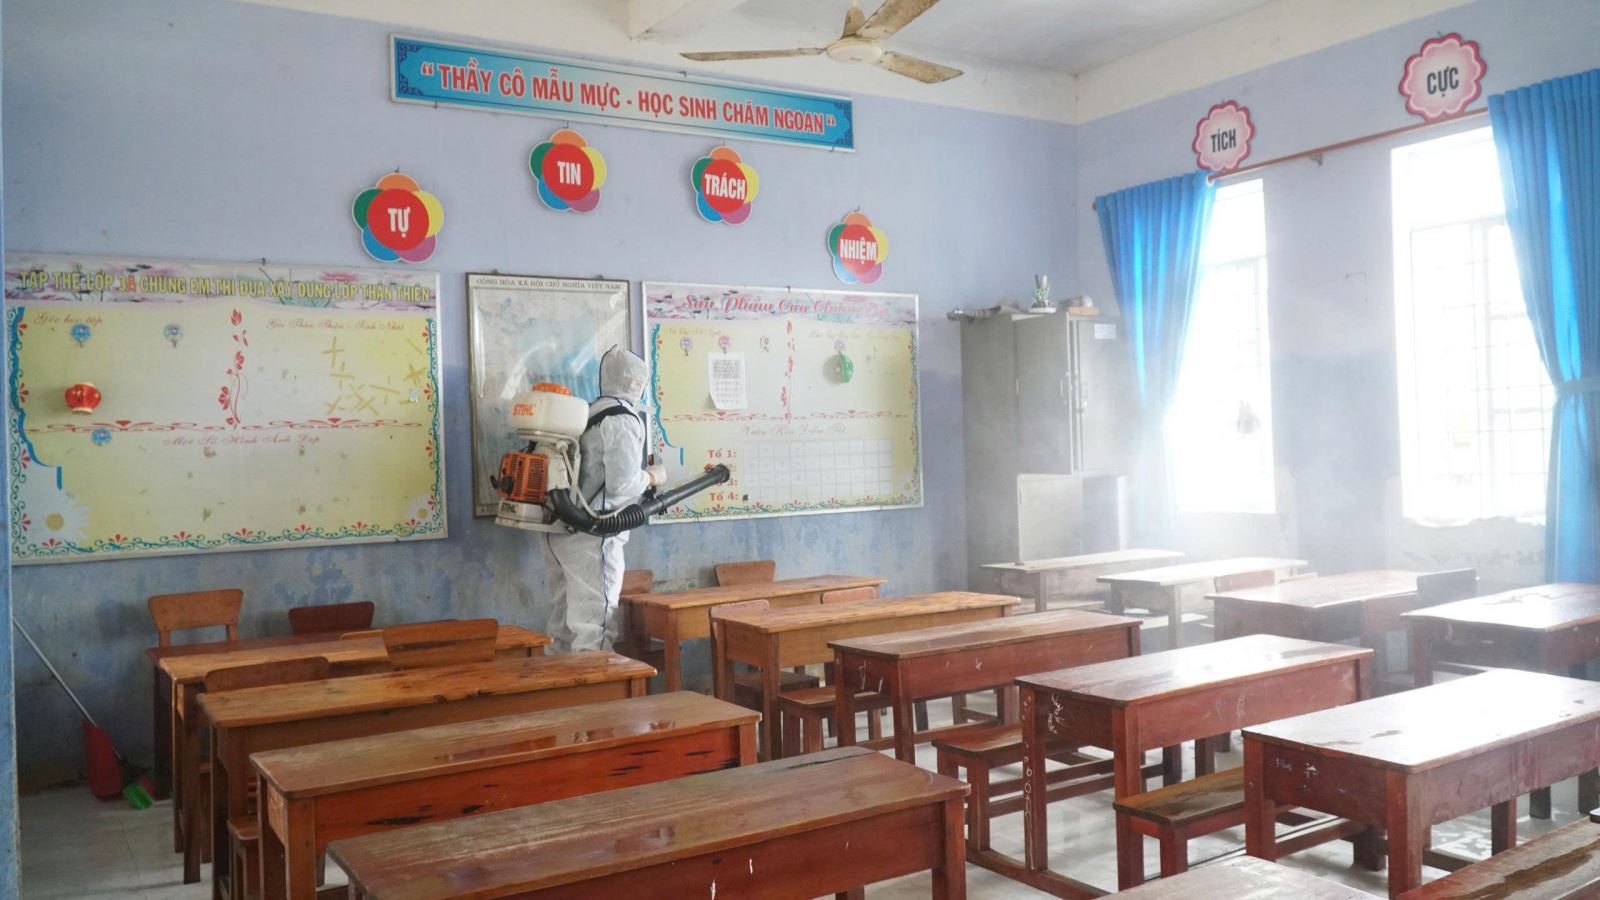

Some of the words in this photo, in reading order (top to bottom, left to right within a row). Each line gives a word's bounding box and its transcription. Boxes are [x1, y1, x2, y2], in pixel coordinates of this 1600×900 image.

[1426, 65, 1459, 97] CỰC
[499, 68, 525, 98] CÔ
[532, 68, 574, 104] MẪU
[580, 82, 621, 112] MỰC
[638, 90, 674, 118] HỌC
[679, 95, 717, 121] SINH
[723, 101, 769, 127] CHĂM
[1210, 128, 1236, 153] TÍCH
[557, 161, 582, 186] TIN
[705, 172, 746, 200] TRÁCH
[387, 206, 411, 238] TỰ
[840, 237, 877, 264] NHIỆM
[190, 277, 211, 296] EM
[214, 278, 235, 297] THI
[512, 403, 534, 416] STIHL
